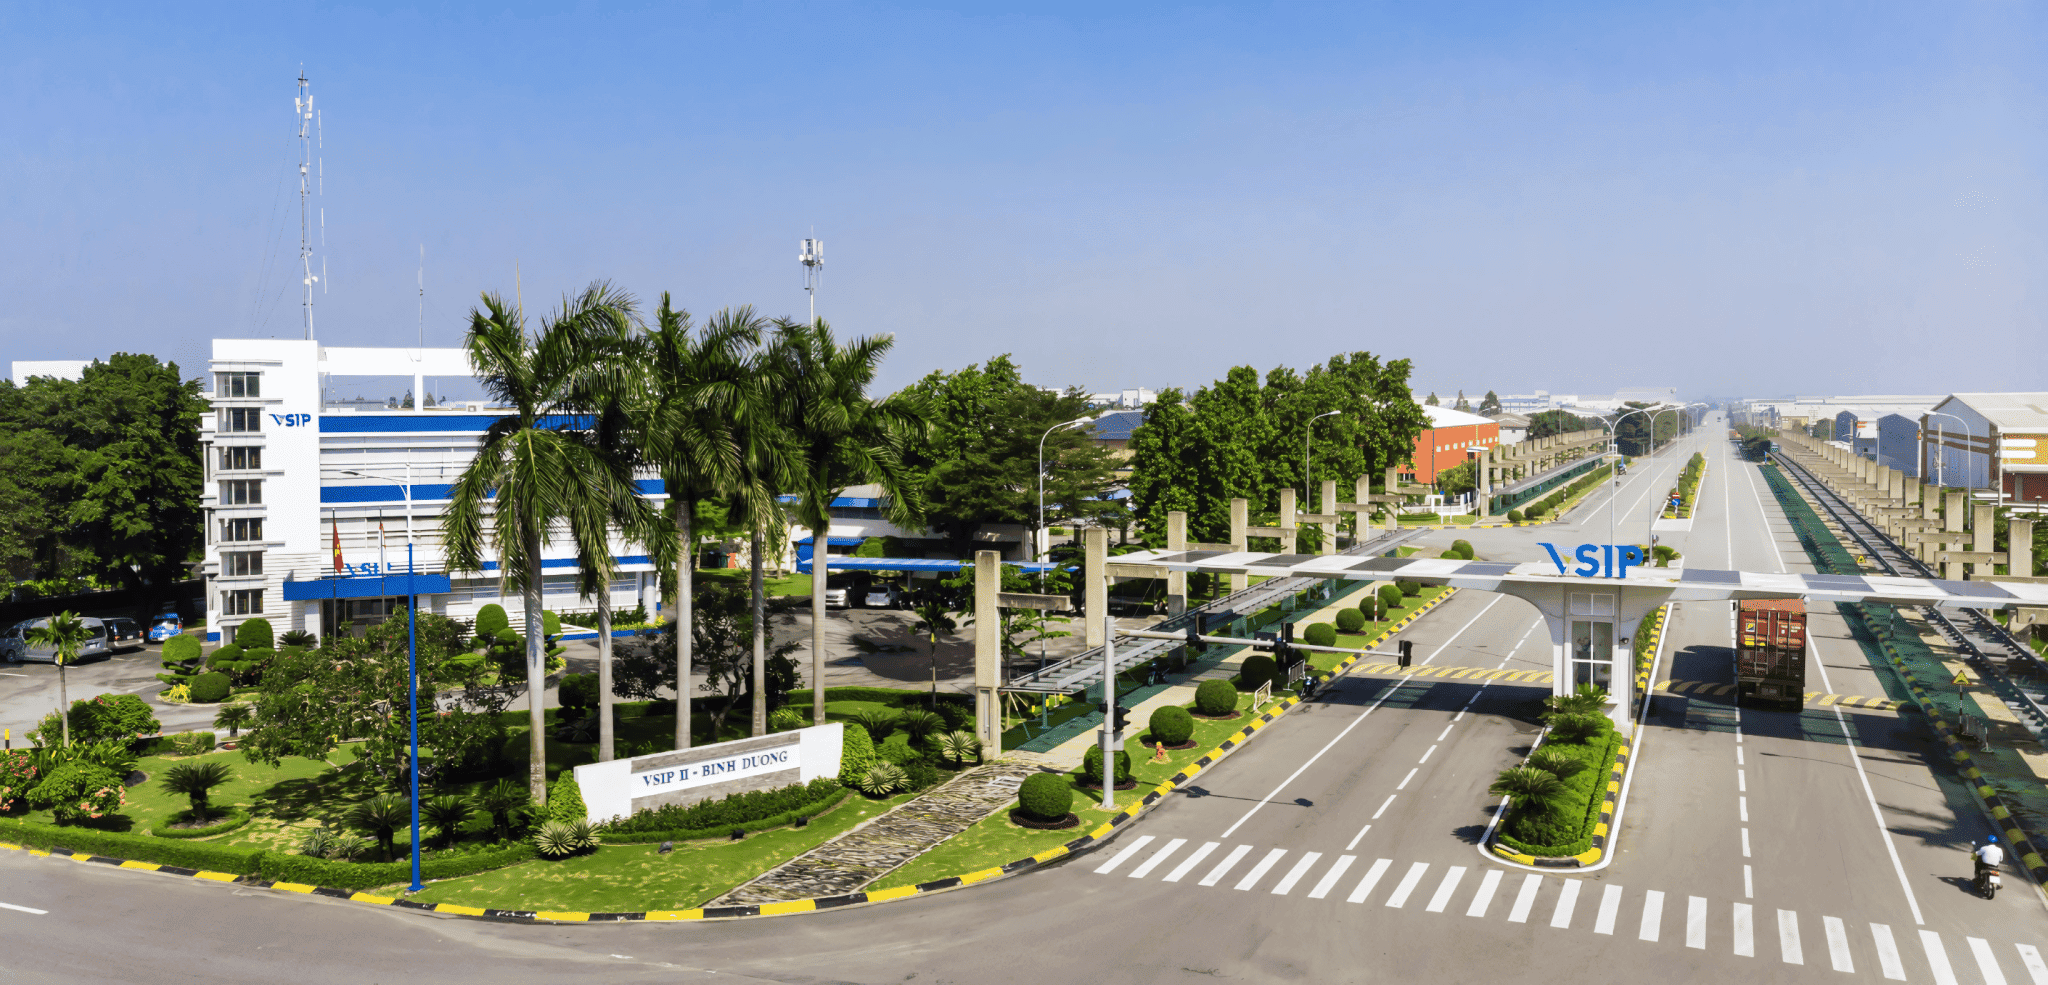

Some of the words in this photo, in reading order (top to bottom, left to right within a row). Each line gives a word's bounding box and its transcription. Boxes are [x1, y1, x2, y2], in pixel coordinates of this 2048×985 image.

[269, 413, 312, 427] VSIP
[1536, 542, 1644, 579] VSIP
[643, 771, 675, 786] VSIP
[679, 768, 689, 781] II
[701, 760, 736, 777] BINH
[742, 751, 788, 770] DUONG
